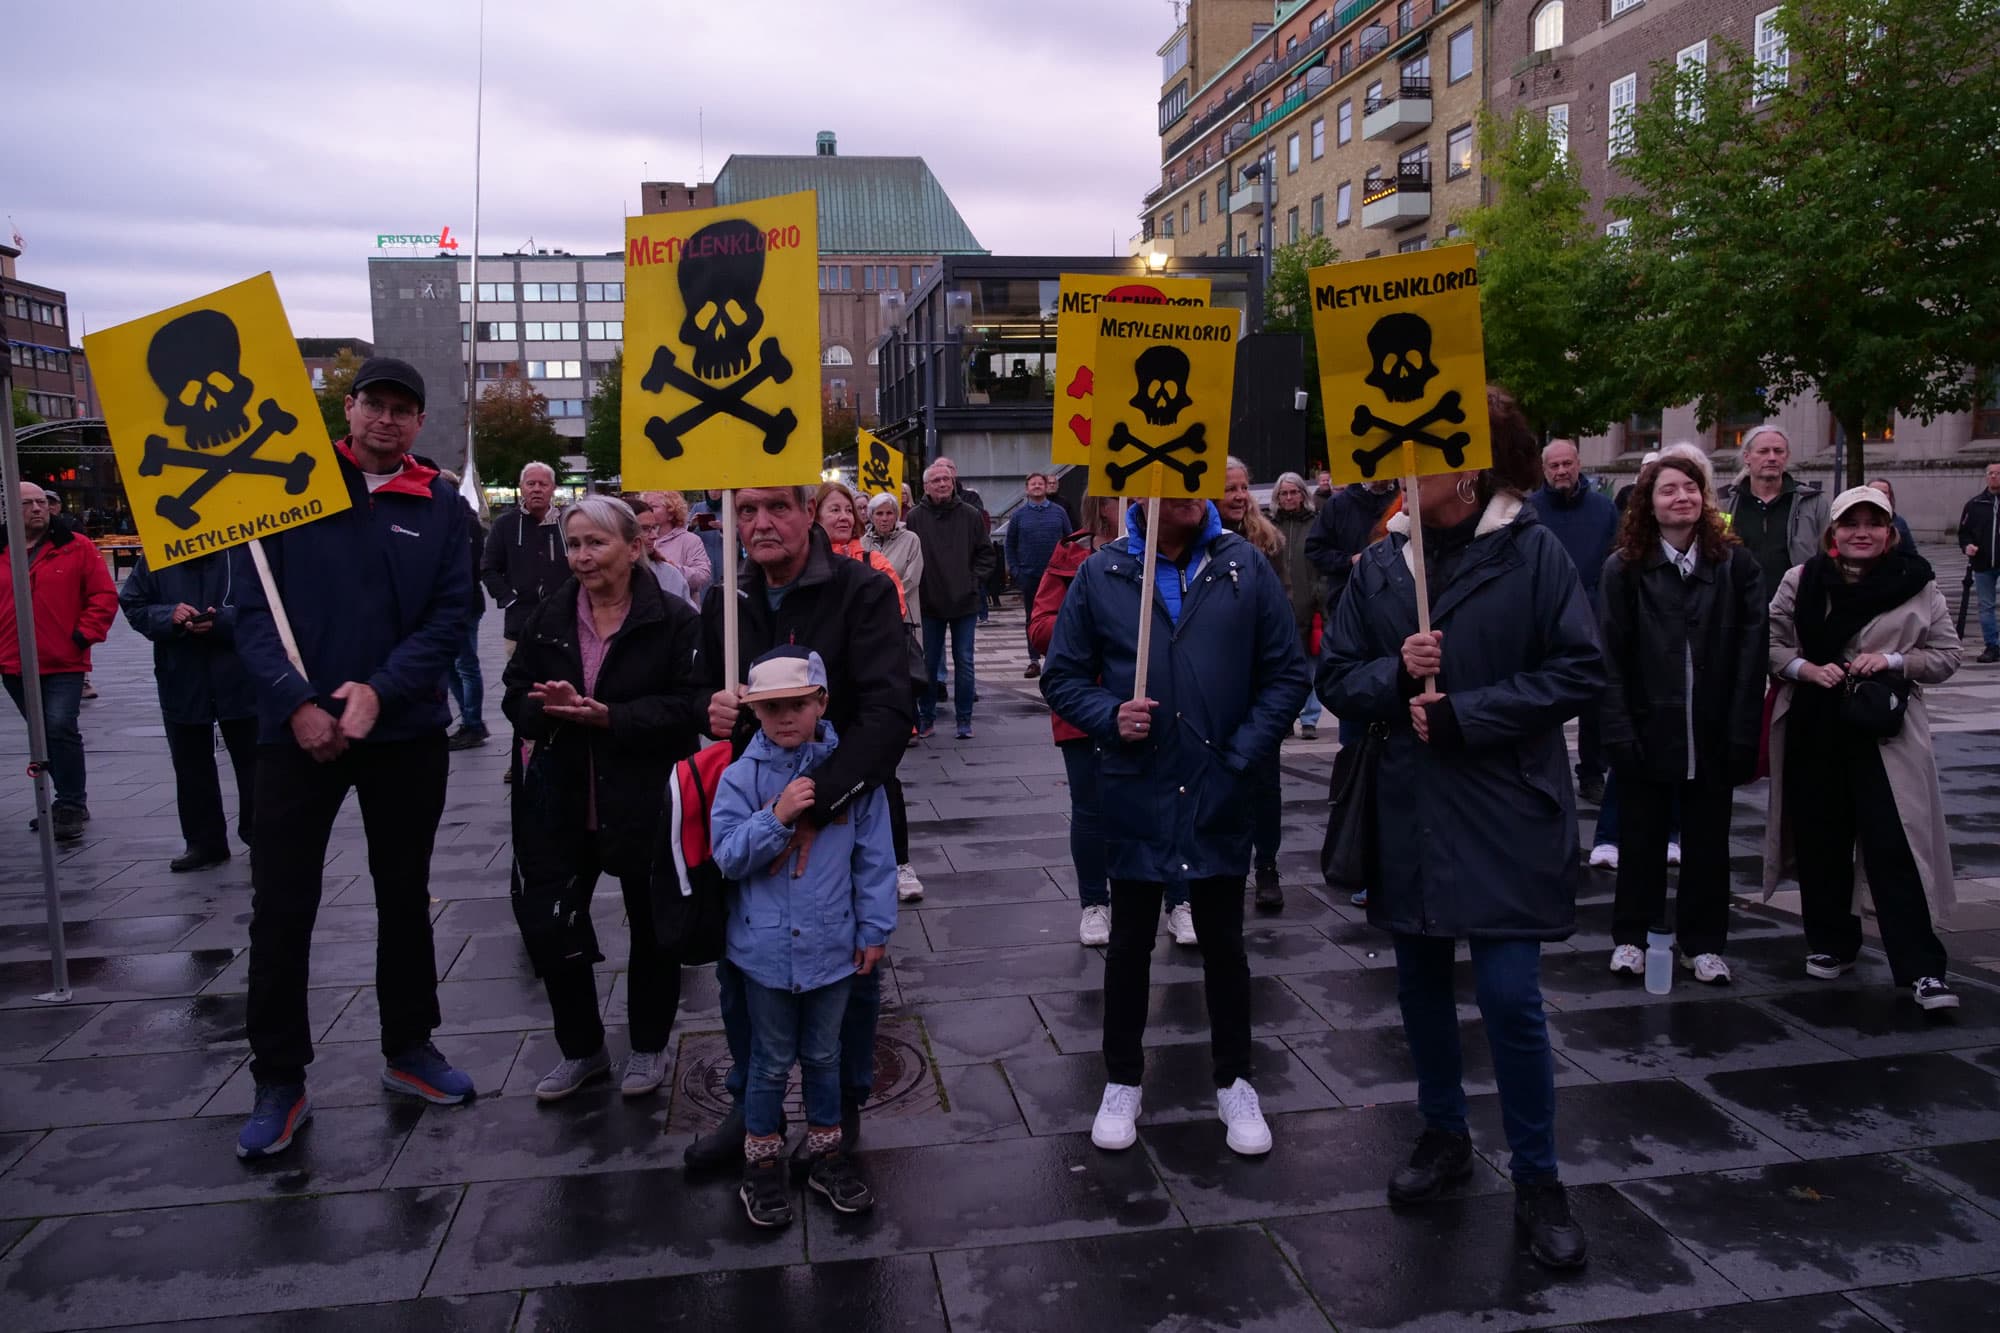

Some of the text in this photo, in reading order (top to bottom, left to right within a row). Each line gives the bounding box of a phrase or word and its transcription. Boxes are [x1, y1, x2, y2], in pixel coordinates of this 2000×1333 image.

[377, 235, 440, 248] FRISTADS
[1316, 268, 1478, 311] METYLENKLORID
[1101, 318, 1231, 342] METYLENKLORID
[164, 499, 323, 561] METYLENKLORID
